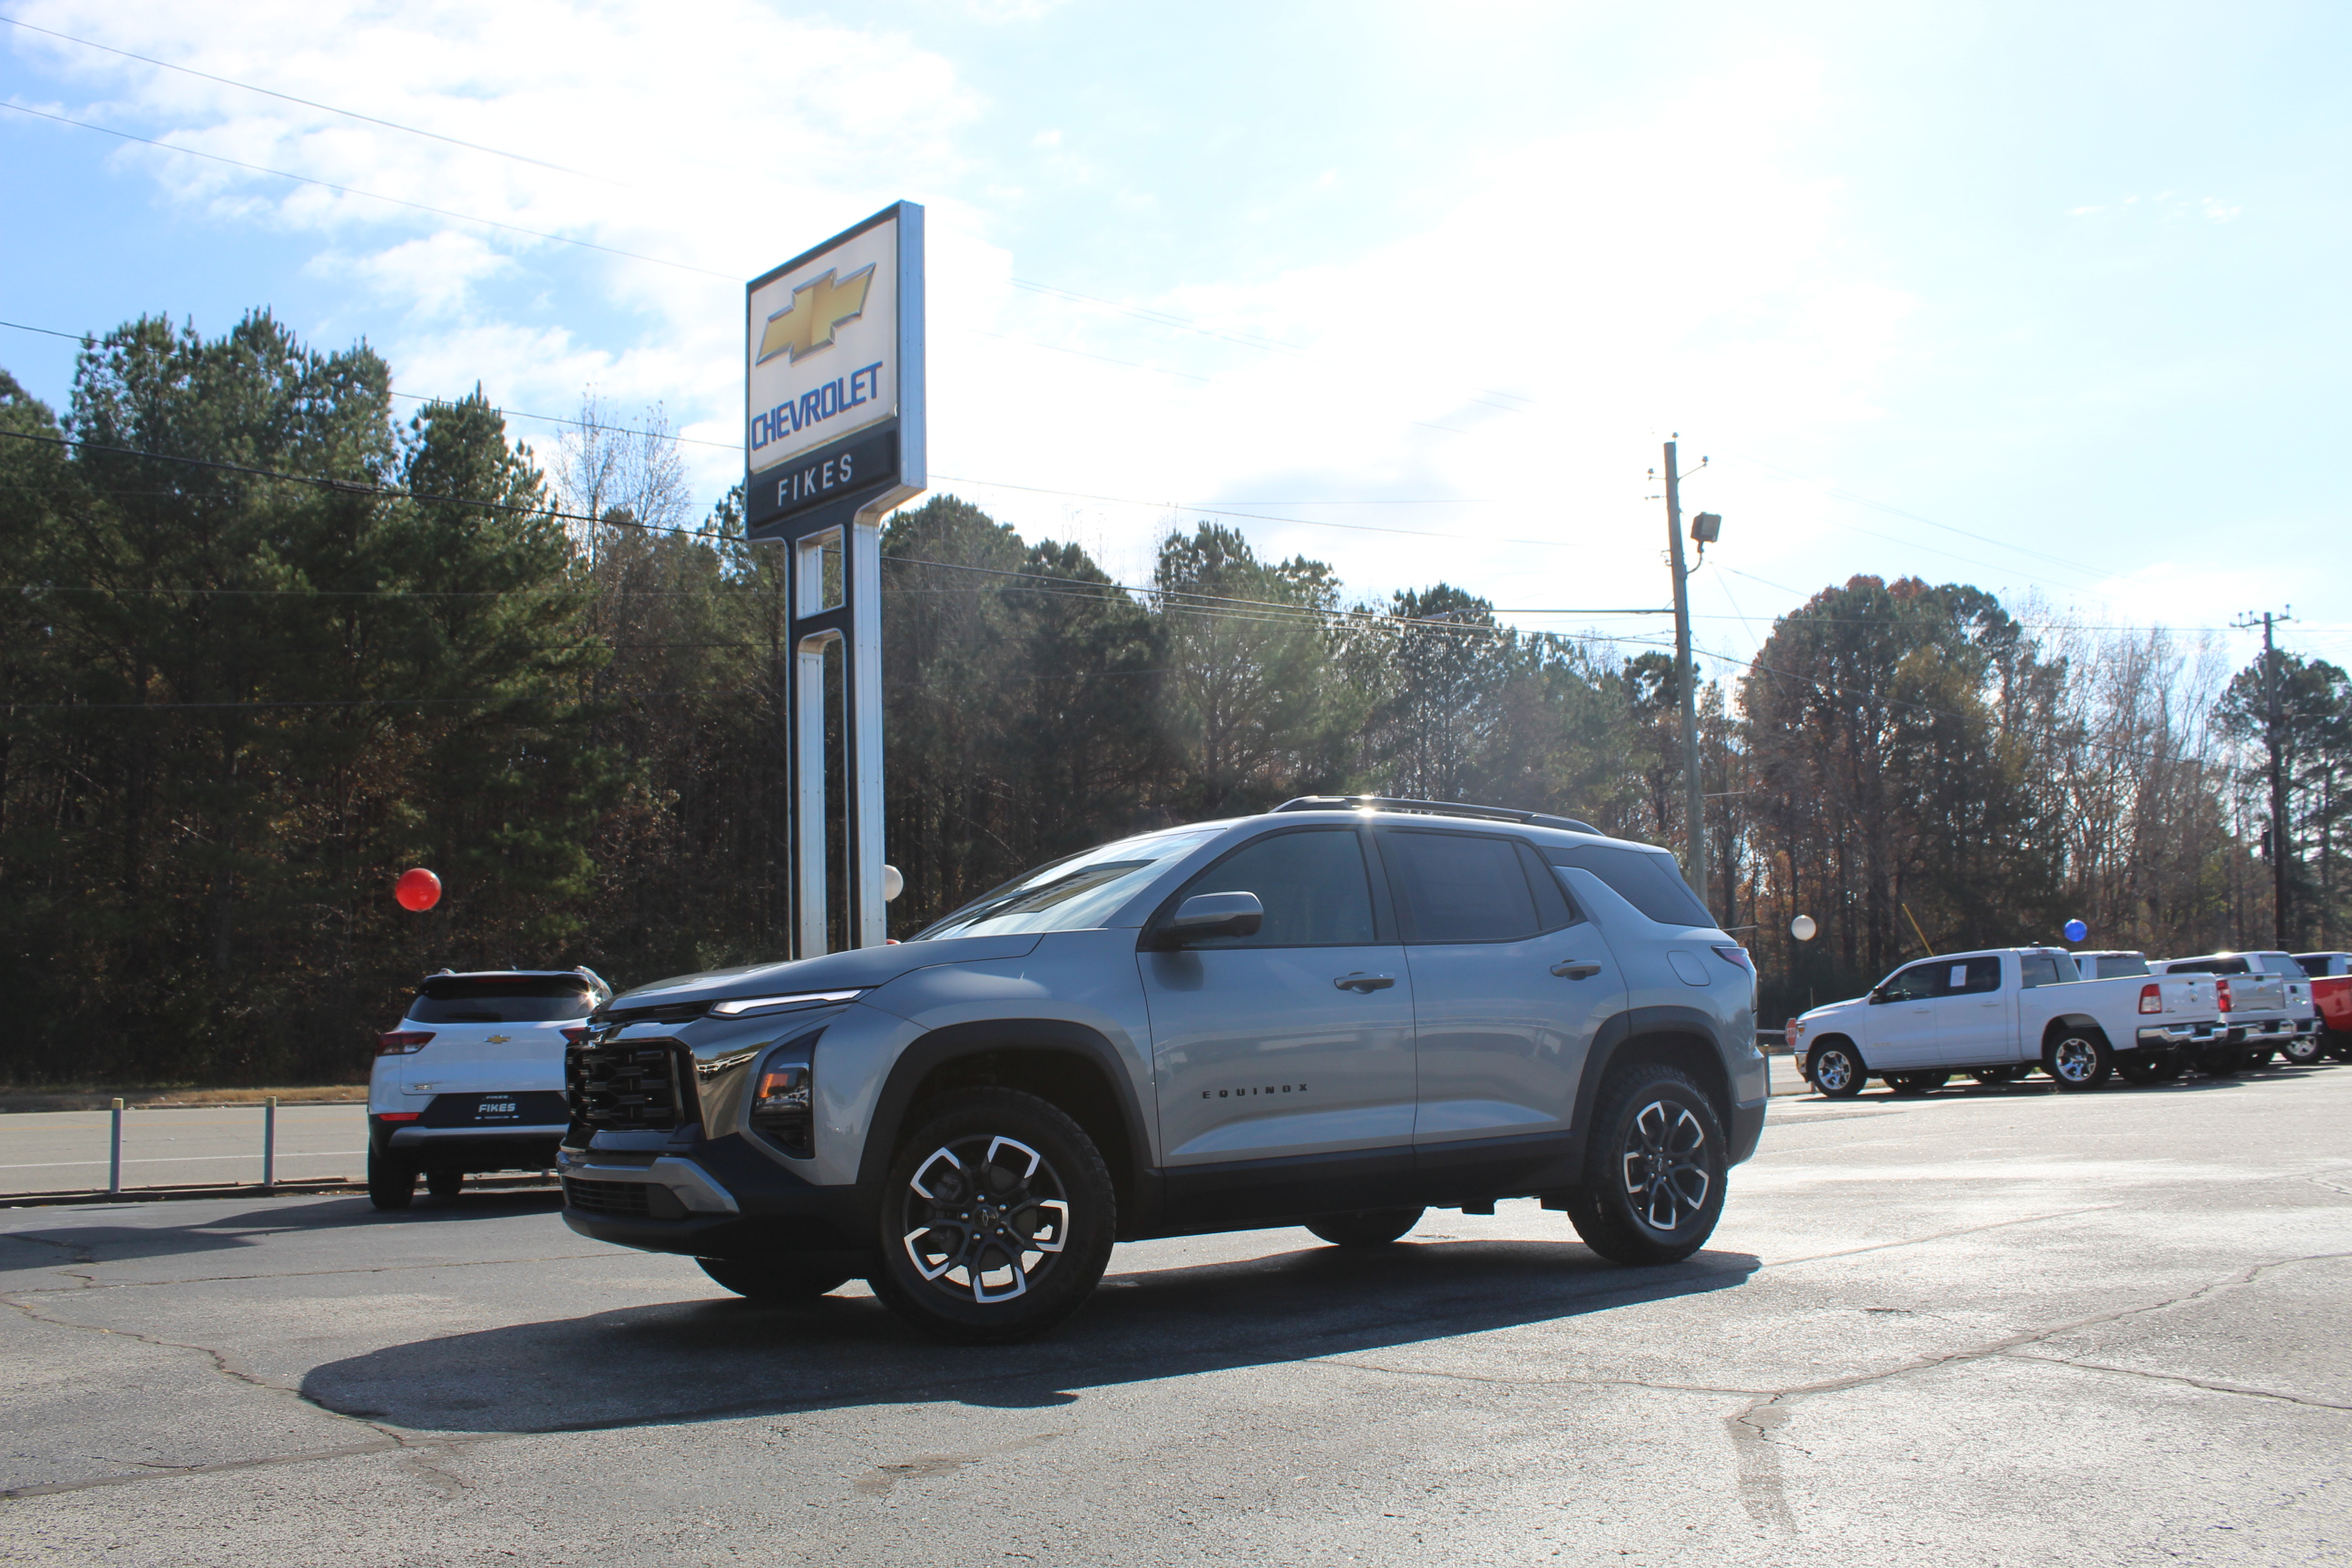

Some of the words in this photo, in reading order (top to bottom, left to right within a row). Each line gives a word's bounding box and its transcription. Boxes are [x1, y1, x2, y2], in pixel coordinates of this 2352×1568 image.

[751, 361, 883, 451] CHEVROLET
[777, 454, 853, 506] FIKES
[1786, 1027, 1797, 1038] STO
[1201, 1083, 1308, 1099] EQUINOX
[478, 1102, 516, 1112] FIKES
